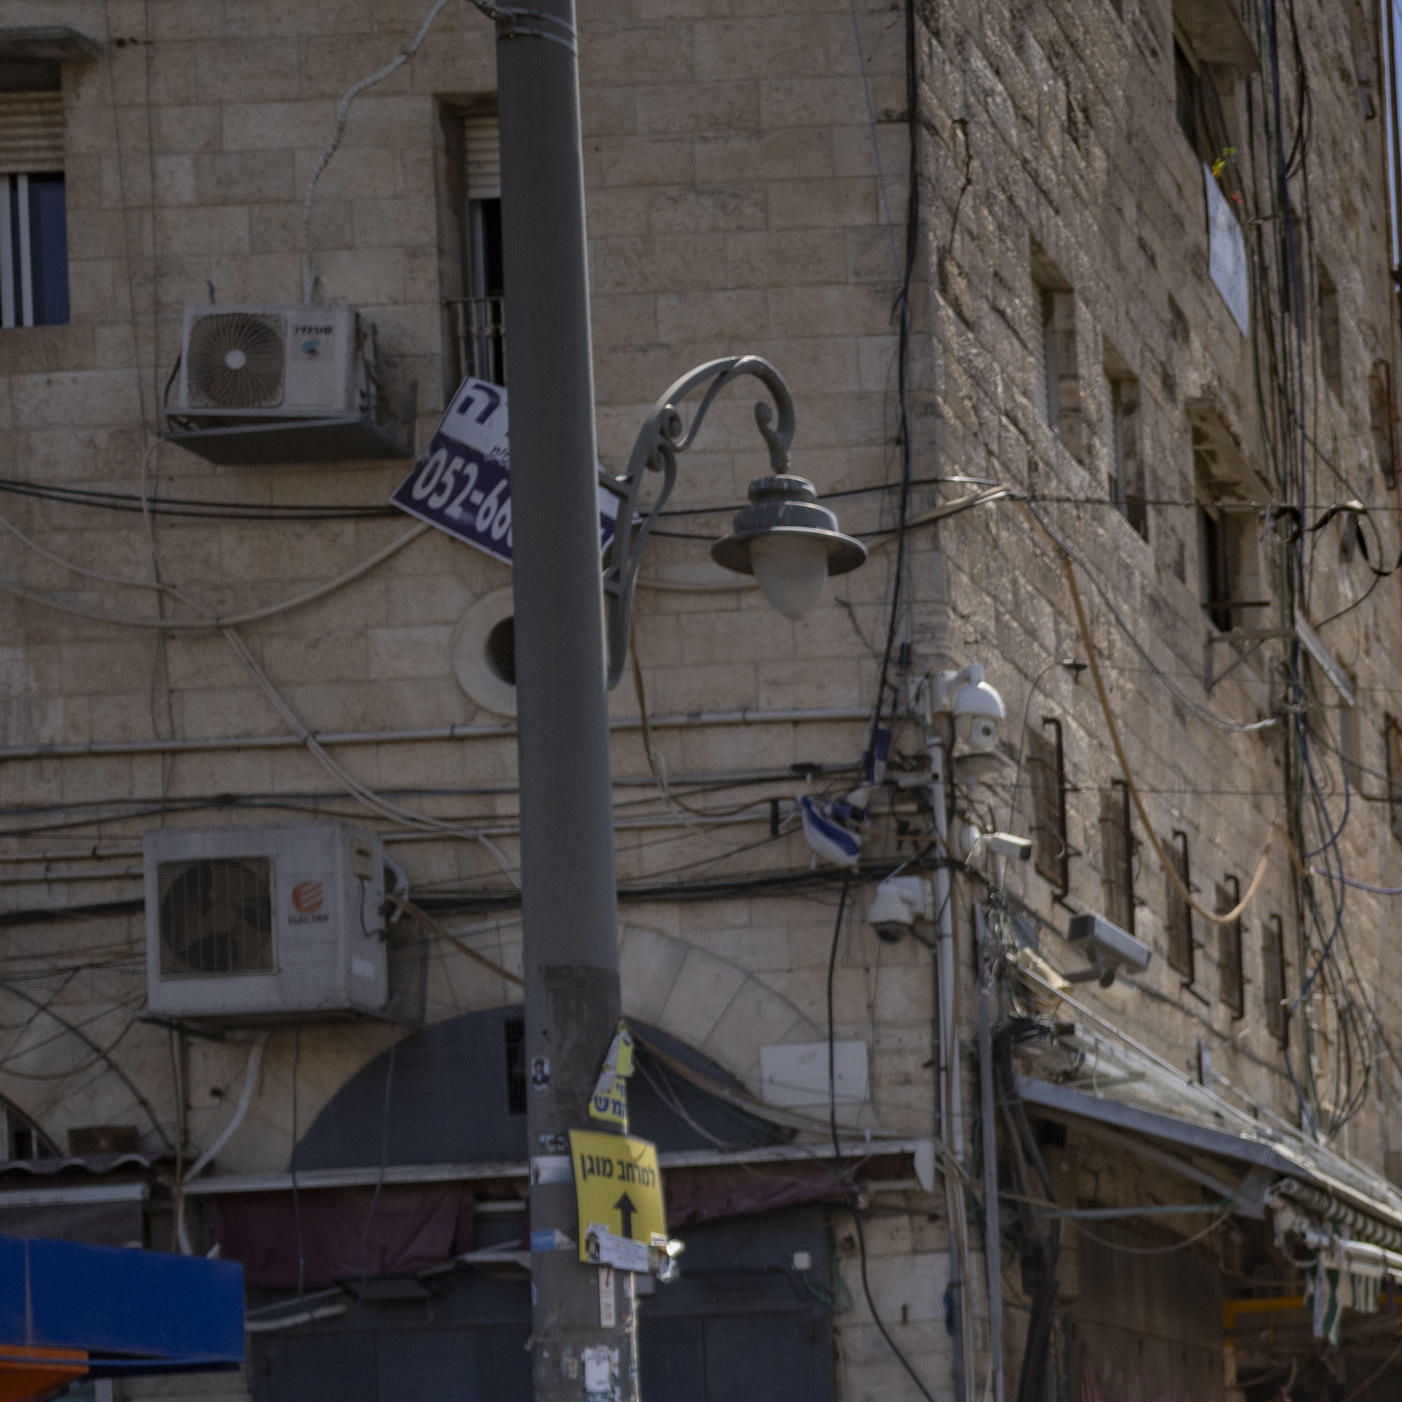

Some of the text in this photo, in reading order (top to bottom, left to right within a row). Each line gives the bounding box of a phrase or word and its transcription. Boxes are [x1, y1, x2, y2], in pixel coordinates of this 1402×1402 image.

[411, 448, 512, 548] 052-66
[579, 1153, 656, 1187] למרחב מוגן
